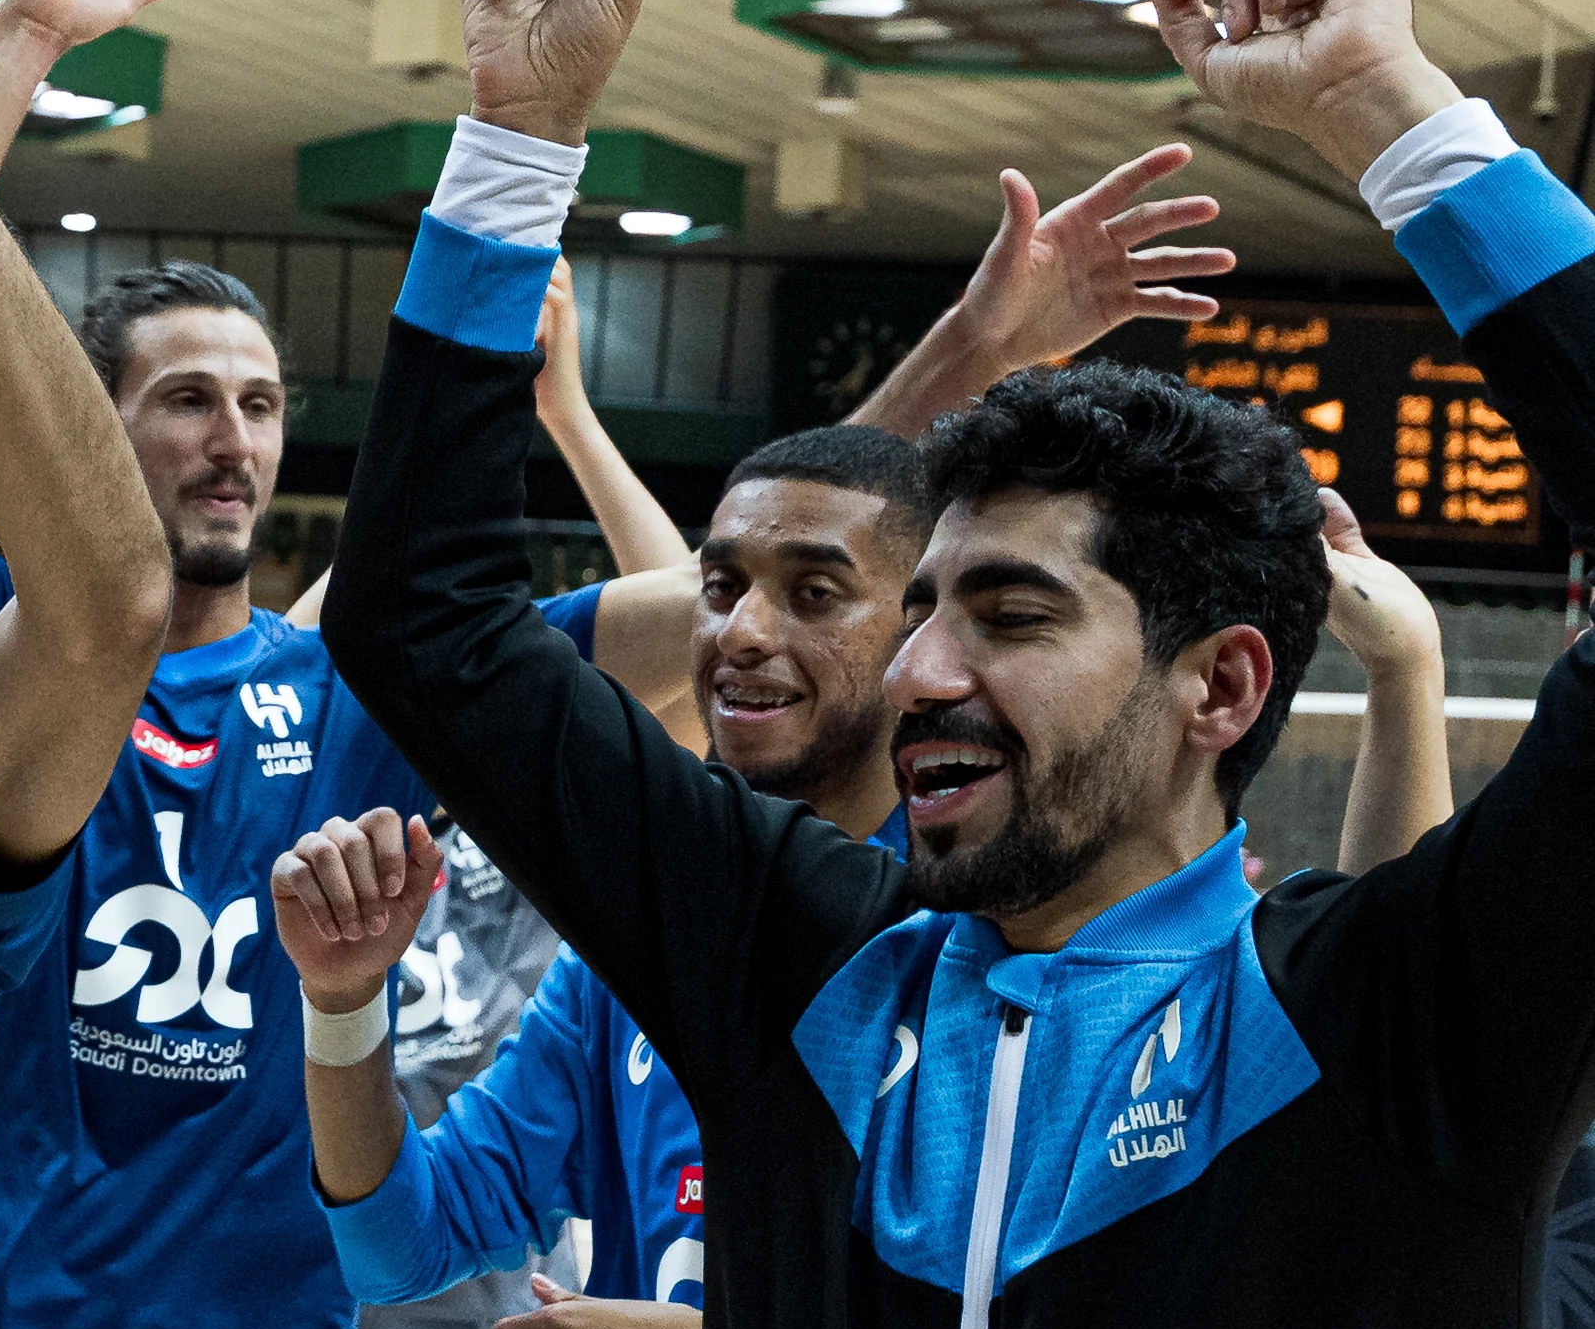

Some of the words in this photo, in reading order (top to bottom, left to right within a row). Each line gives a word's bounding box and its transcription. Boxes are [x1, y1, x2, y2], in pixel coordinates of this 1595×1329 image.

[69, 1039, 126, 1071] Saudi
[132, 1057, 247, 1082] Downtown
[1106, 1098, 1187, 1141] ALHILAL
[1109, 1126, 1187, 1168] الهلال
